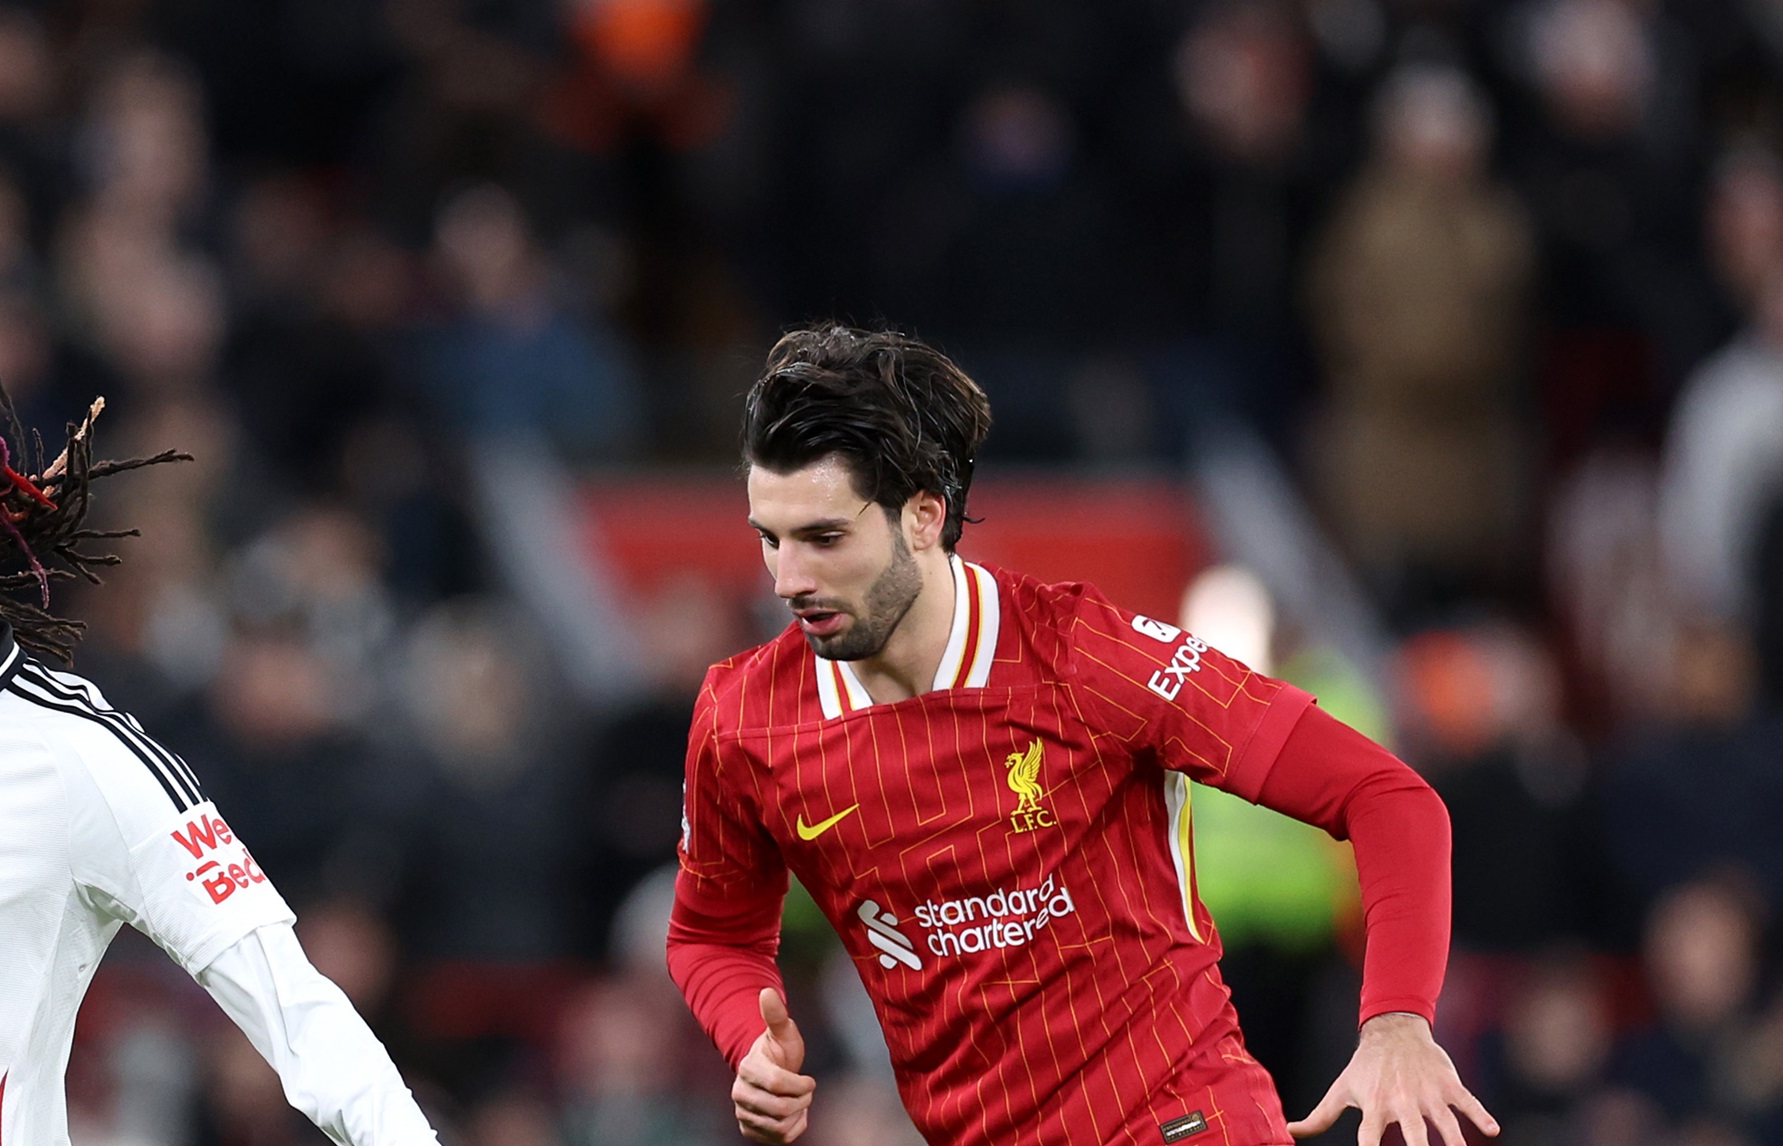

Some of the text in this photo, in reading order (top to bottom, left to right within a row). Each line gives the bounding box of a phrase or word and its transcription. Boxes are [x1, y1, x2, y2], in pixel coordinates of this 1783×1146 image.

[1147, 636, 1209, 701] Expe
[914, 872, 1055, 929] standard
[927, 886, 1075, 957] chartered
